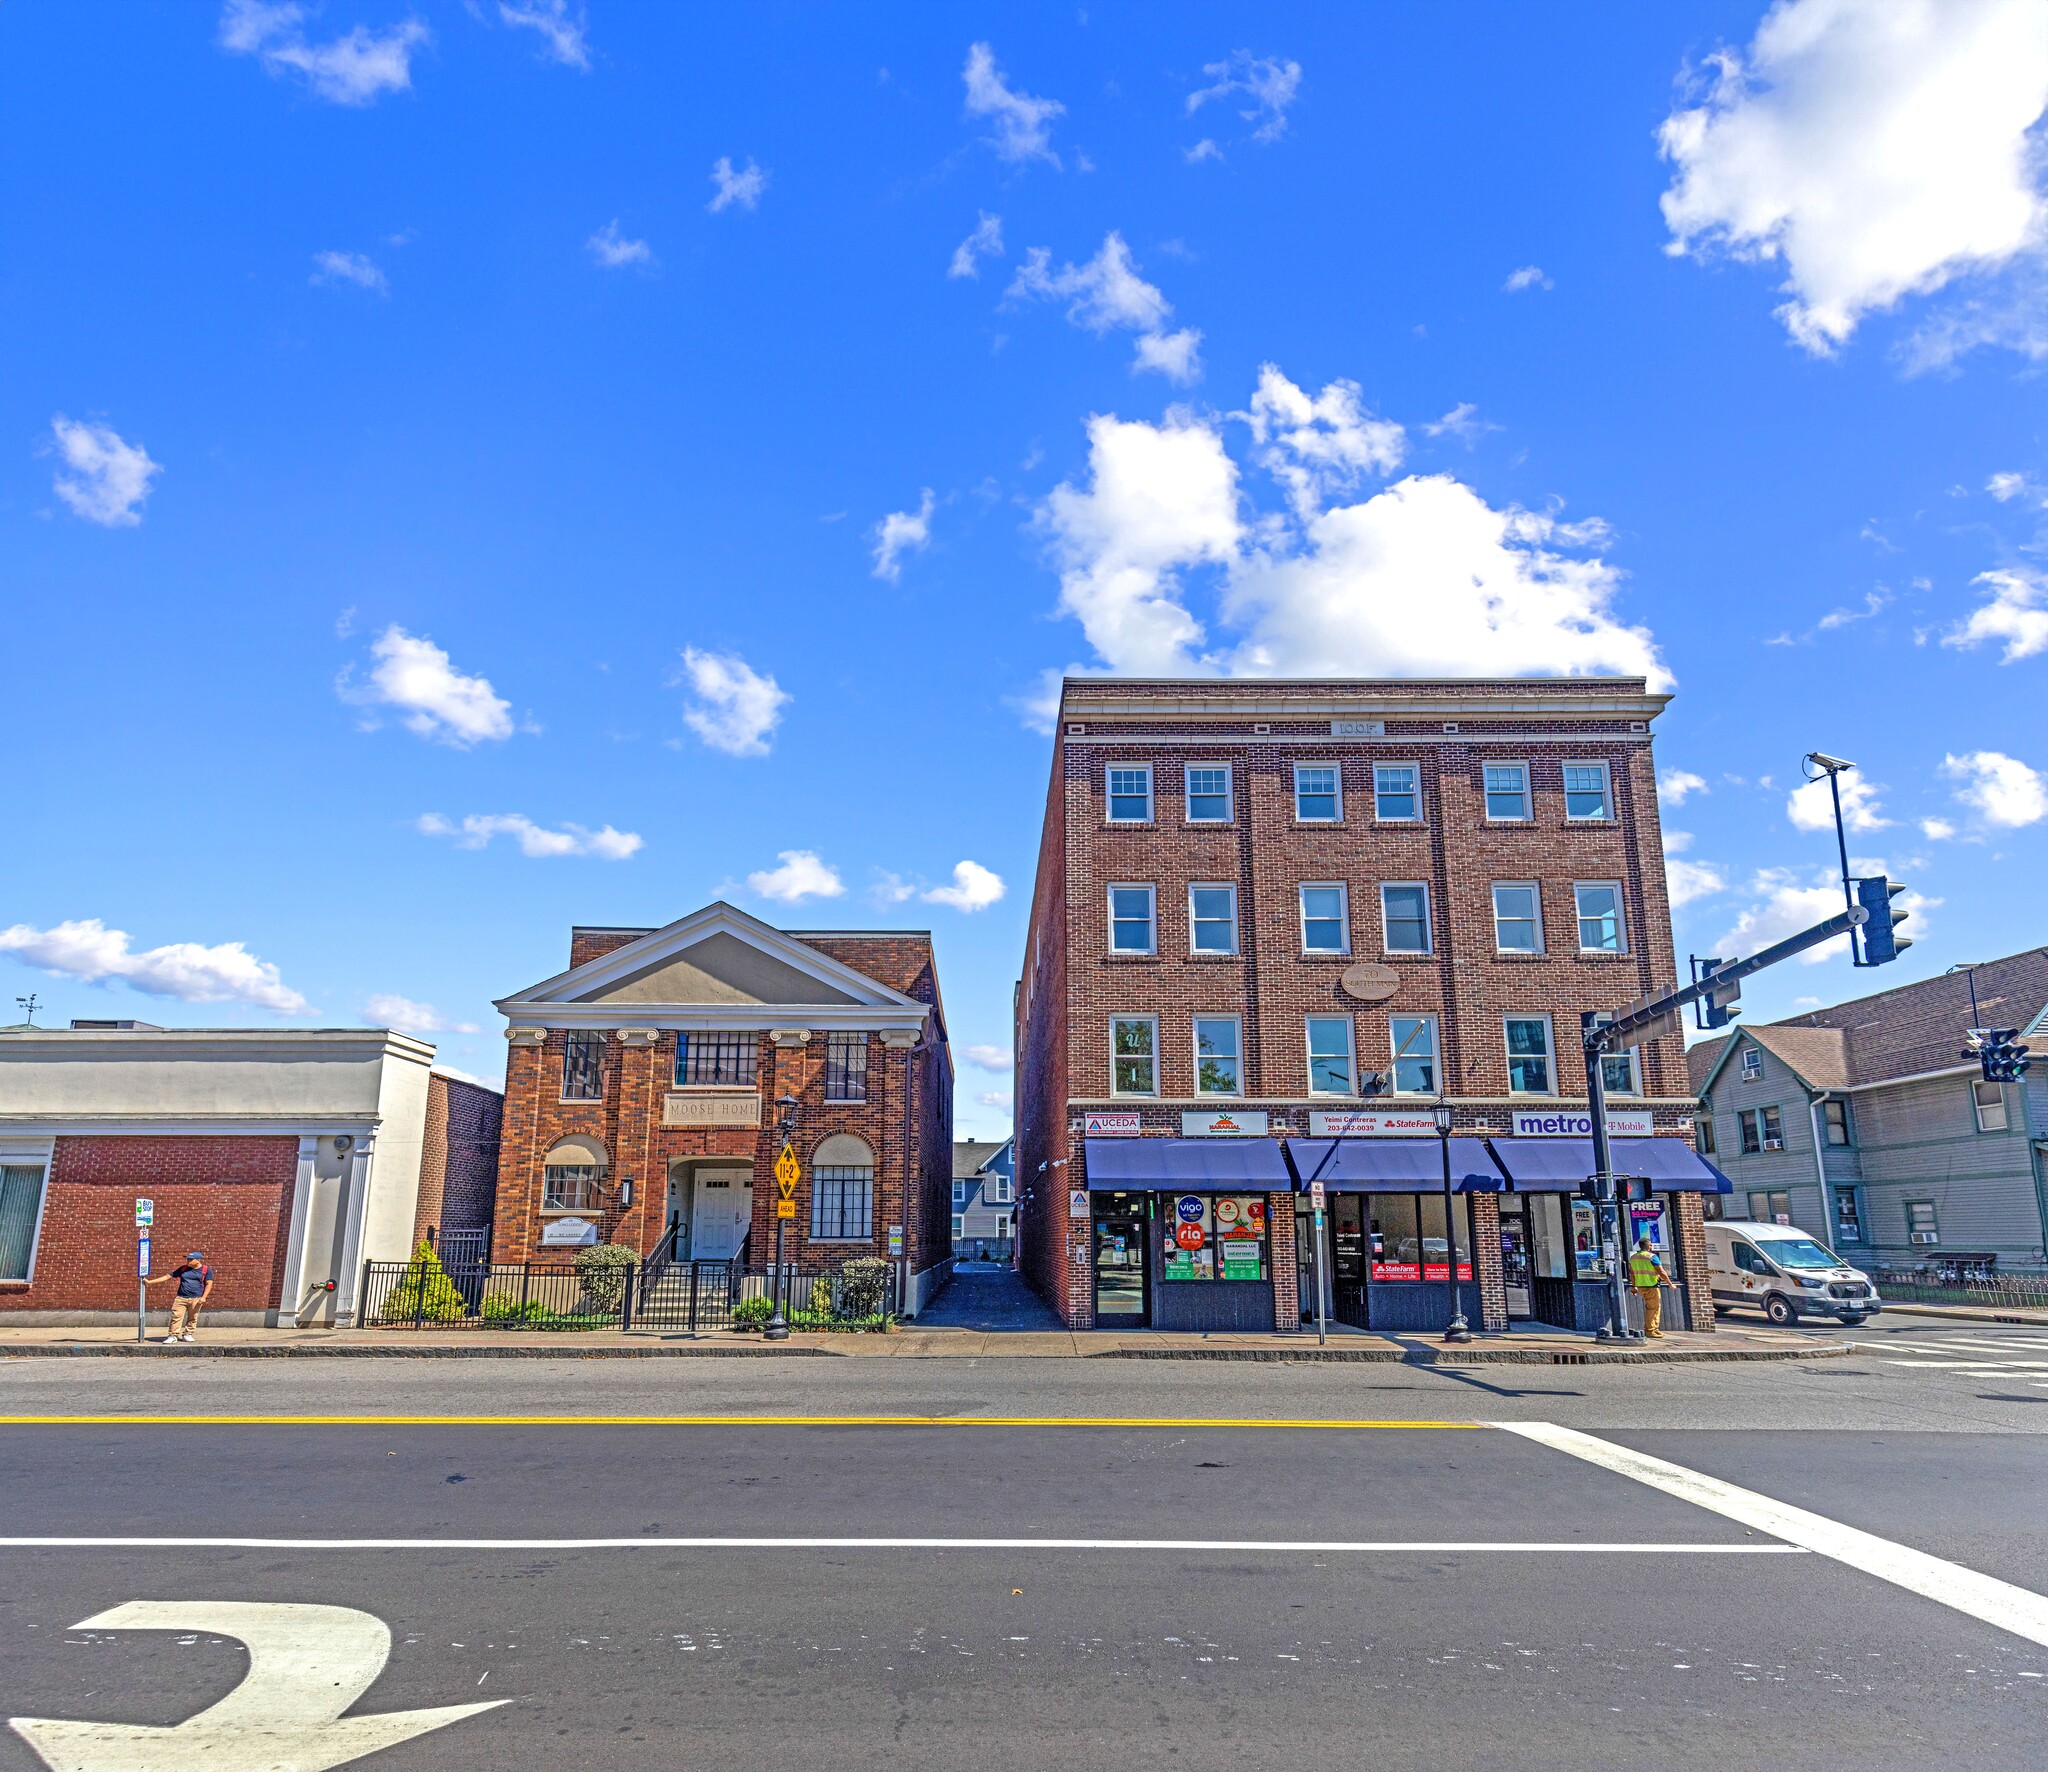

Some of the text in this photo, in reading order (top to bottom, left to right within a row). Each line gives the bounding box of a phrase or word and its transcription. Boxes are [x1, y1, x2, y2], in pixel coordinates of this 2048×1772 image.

[1363, 969, 1379, 979] 70
[670, 1103, 756, 1115] MOOSE HOME
[1102, 1119, 1137, 1127] UCEDA
[1520, 1114, 1592, 1133] metro
[1617, 1121, 1646, 1131] Mobile
[780, 1205, 793, 1213] AHEAD
[1179, 1202, 1202, 1213] vigo
[1631, 1201, 1661, 1211] FREE
[1180, 1225, 1202, 1240] ria
[1224, 1231, 1257, 1240] NARANJAL
